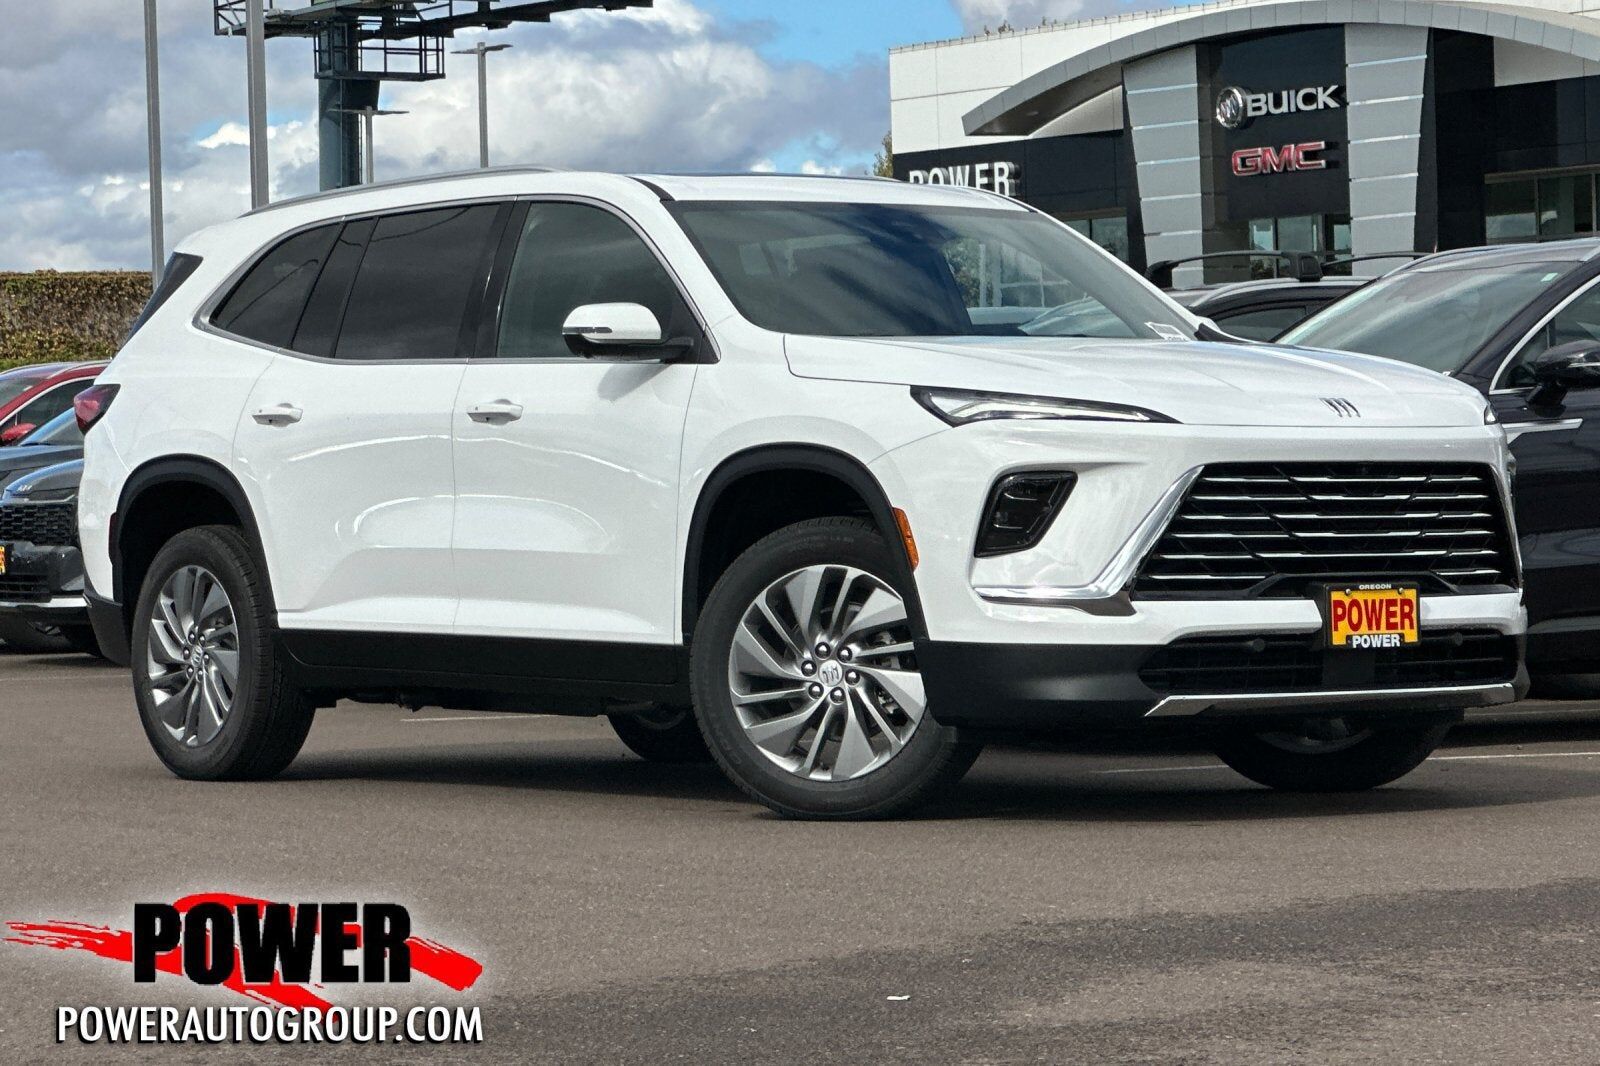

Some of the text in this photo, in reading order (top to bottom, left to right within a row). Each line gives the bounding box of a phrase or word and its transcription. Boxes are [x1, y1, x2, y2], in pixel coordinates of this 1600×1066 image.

[1247, 85, 1340, 117] BUICK
[1232, 141, 1326, 176] GMC
[1332, 598, 1415, 631] POWER
[1352, 634, 1400, 648] POWER
